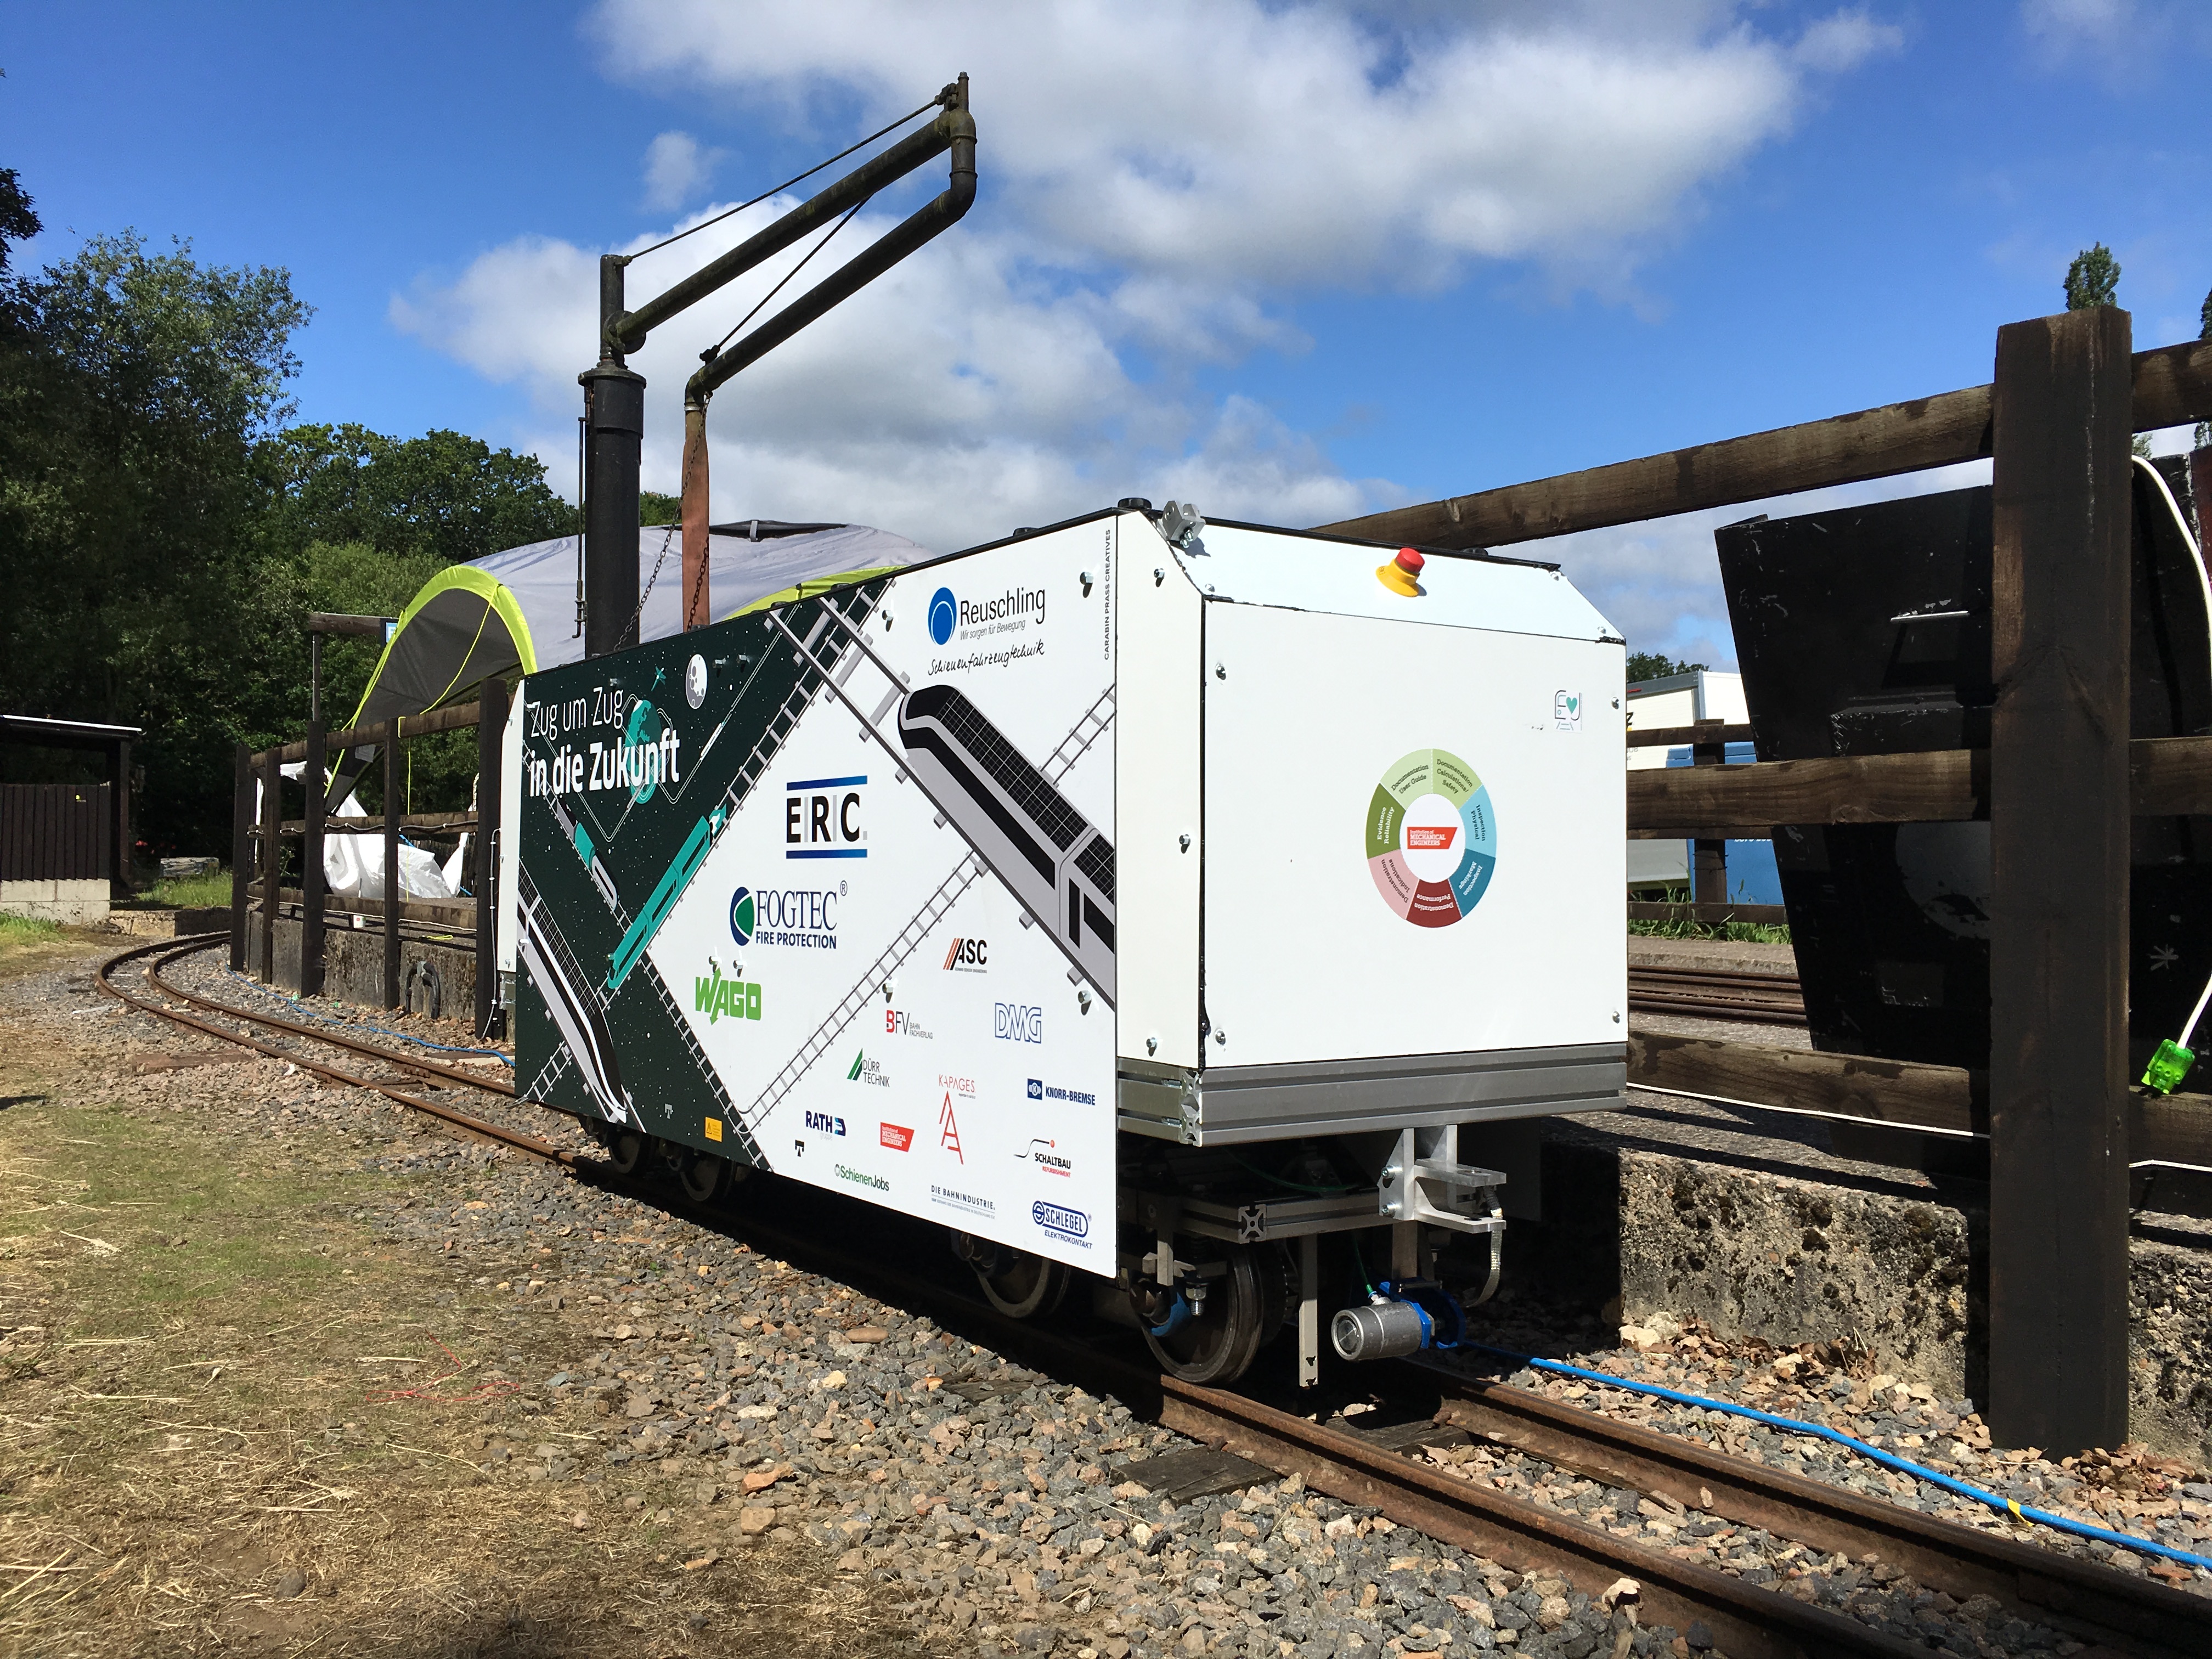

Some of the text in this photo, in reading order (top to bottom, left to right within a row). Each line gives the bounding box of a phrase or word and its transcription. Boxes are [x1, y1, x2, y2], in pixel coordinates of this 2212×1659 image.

[960, 587, 1045, 624] Reuschling
[960, 620, 1026, 640] Wir sorgen für Bewegung
[928, 639, 1045, 676] Schienenfahrzeugtechnik
[531, 686, 623, 741] Zug um Zug
[529, 727, 680, 797] in die Zukunft
[1437, 759, 1472, 787] Documentation
[1391, 765, 1429, 791] Documentation
[1398, 774, 1426, 794] User Guide
[1442, 780, 1458, 794] Safety
[1377, 807, 1386, 840] Evidence
[1384, 807, 1395, 844] Reliability
[1470, 810, 1480, 840] Physical
[1476, 804, 1486, 841] Inspection
[1381, 859, 1409, 903] Demonstration
[1389, 859, 1410, 893] Indications
[1458, 861, 1477, 889] Markings
[1463, 865, 1482, 896] Inspection
[756, 890, 837, 931] FOGTEC
[756, 931, 837, 949] FIRE PROTECTION
[950, 938, 987, 970] ASC
[695, 974, 761, 1022] WAGO
[887, 1010, 910, 1035] BFV
[910, 1029, 933, 1039] FACHVERLAG
[995, 1002, 1041, 1043] DMG
[863, 1058, 880, 1073] DÜRR
[864, 1073, 890, 1087] TECHNIK
[939, 1074, 975, 1092] KAPAGES
[1046, 1086, 1095, 1105] KNORR-BREMSE
[806, 1110, 833, 1133] RATH
[1035, 1153, 1071, 1169] SCHALTBAU
[840, 1165, 889, 1191] SchienenJobs
[931, 1185, 940, 1194] DIE
[1046, 1208, 1082, 1232] SCHLEGEL
[1045, 1229, 1092, 1249] ELEKTROKONTAKT
